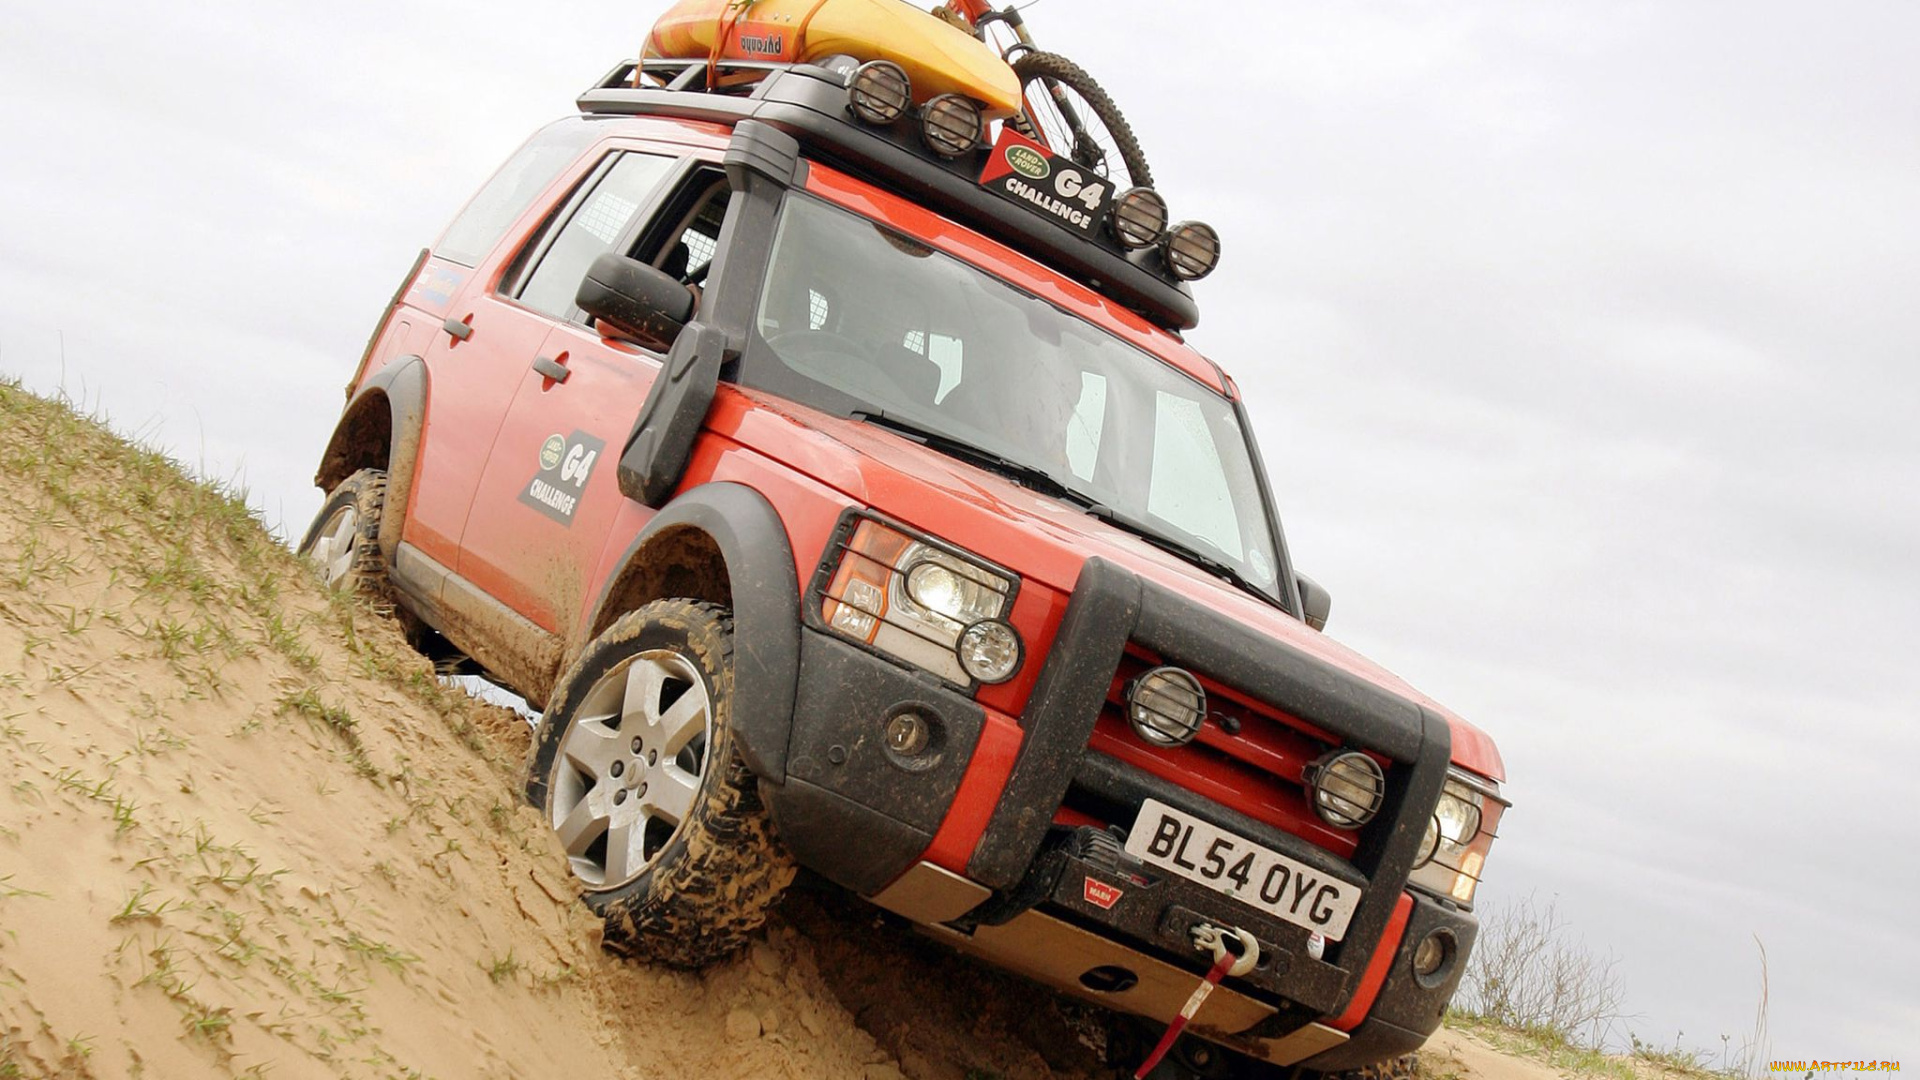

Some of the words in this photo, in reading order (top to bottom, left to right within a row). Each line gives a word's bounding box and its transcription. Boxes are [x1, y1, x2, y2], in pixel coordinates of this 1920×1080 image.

[740, 34, 783, 55] pyranha
[1014, 157, 1042, 176] ROVER
[1015, 149, 1039, 166] LAND
[1005, 178, 1092, 229] CHALLENGE
[1054, 169, 1105, 211] G4
[561, 443, 597, 488] G4
[529, 478, 576, 516] CHALLENGE
[1146, 814, 1256, 891] BL54
[1259, 863, 1340, 925] OYG
